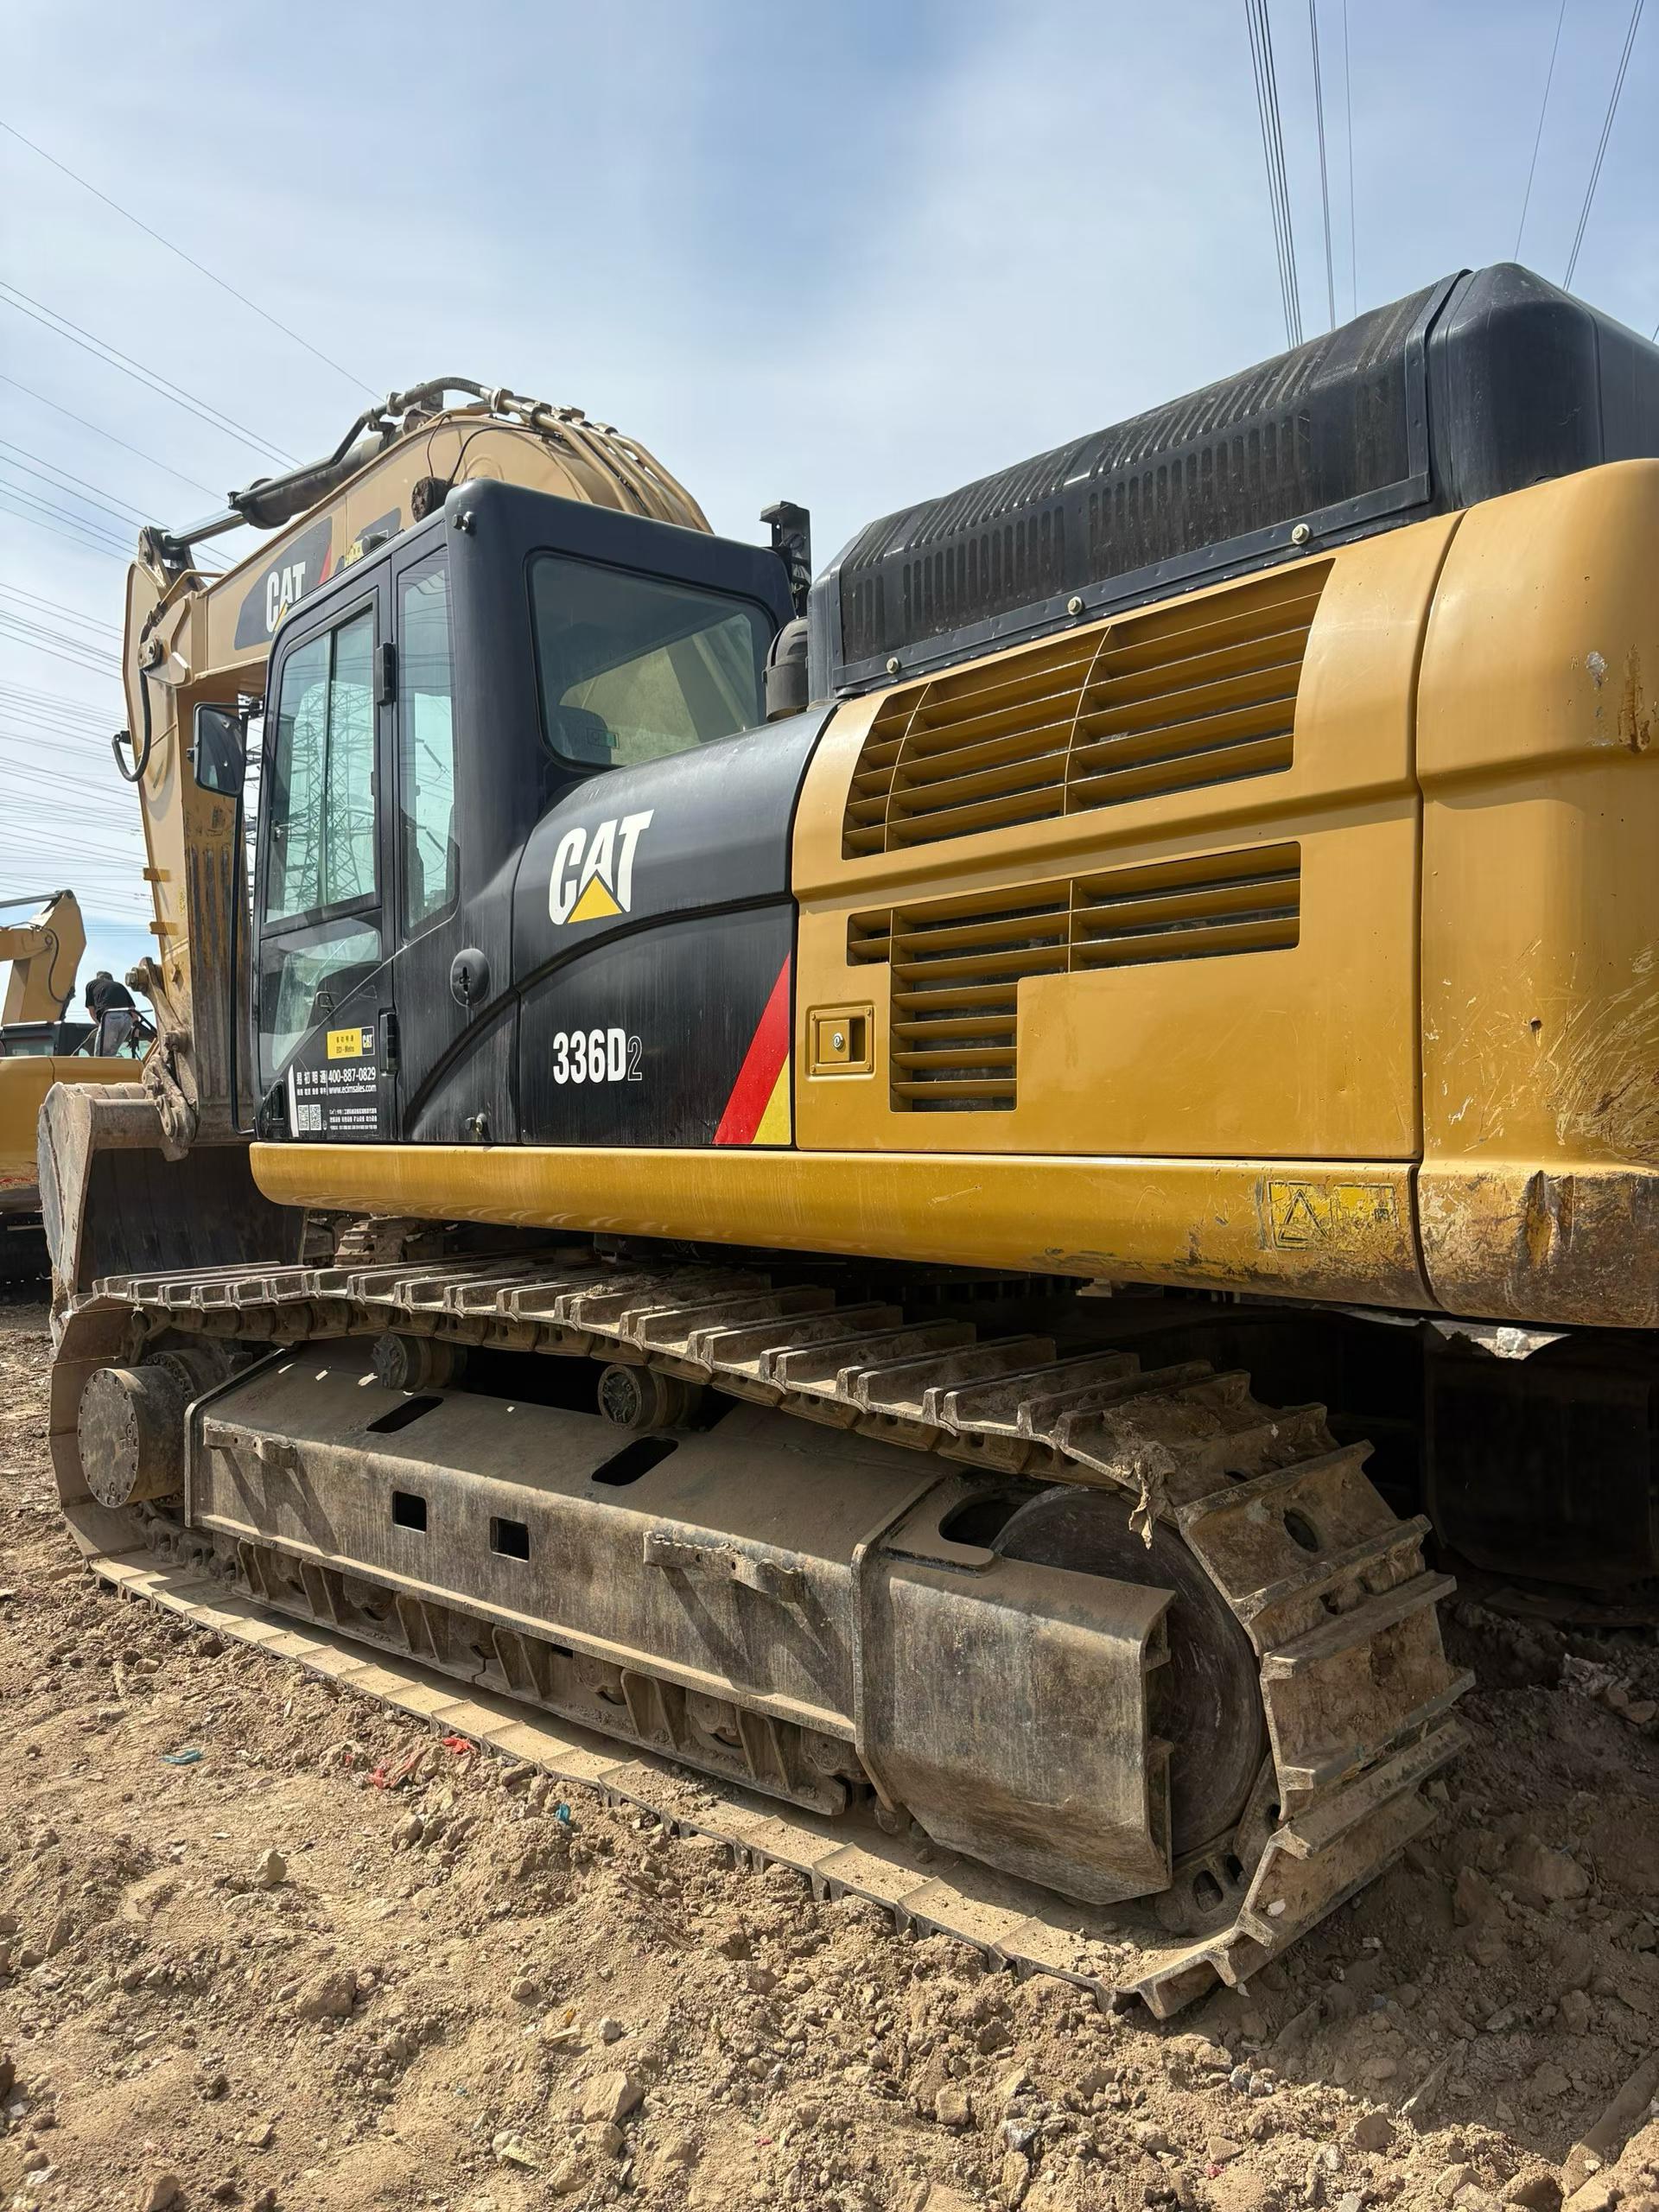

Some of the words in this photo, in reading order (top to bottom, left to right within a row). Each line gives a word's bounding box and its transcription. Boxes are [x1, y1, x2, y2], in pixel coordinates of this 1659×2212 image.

[266, 562, 306, 632] CAT
[549, 809, 655, 926] CAT
[328, 1067, 377, 1083] 400-887-0829
[552, 1027, 643, 1085] 336D2
